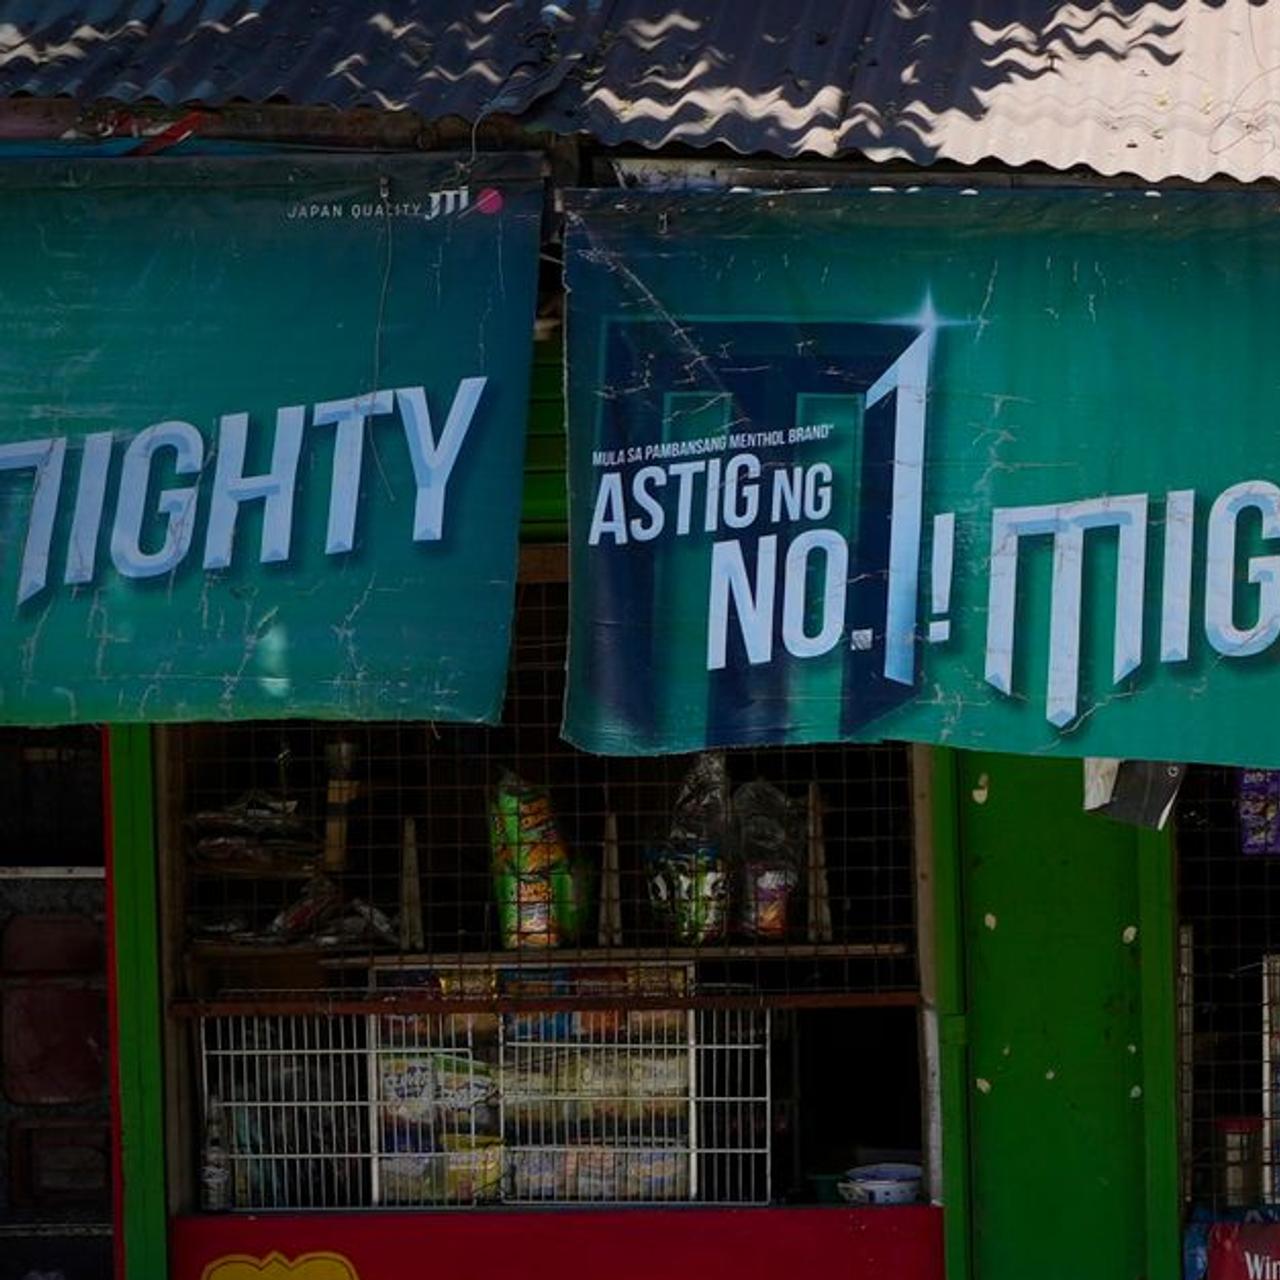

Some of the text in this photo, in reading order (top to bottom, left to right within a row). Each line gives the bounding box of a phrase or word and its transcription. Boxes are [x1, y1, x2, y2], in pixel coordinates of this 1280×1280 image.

[286, 204, 343, 219] JAPAN
[350, 203, 422, 219] QUALITY
[592, 448, 625, 467] MULA
[627, 446, 643, 462] SA
[645, 435, 727, 460] PAMBANSANG
[728, 430, 786, 450] MENTHOL
[587, 453, 833, 546] ASTIG NG
